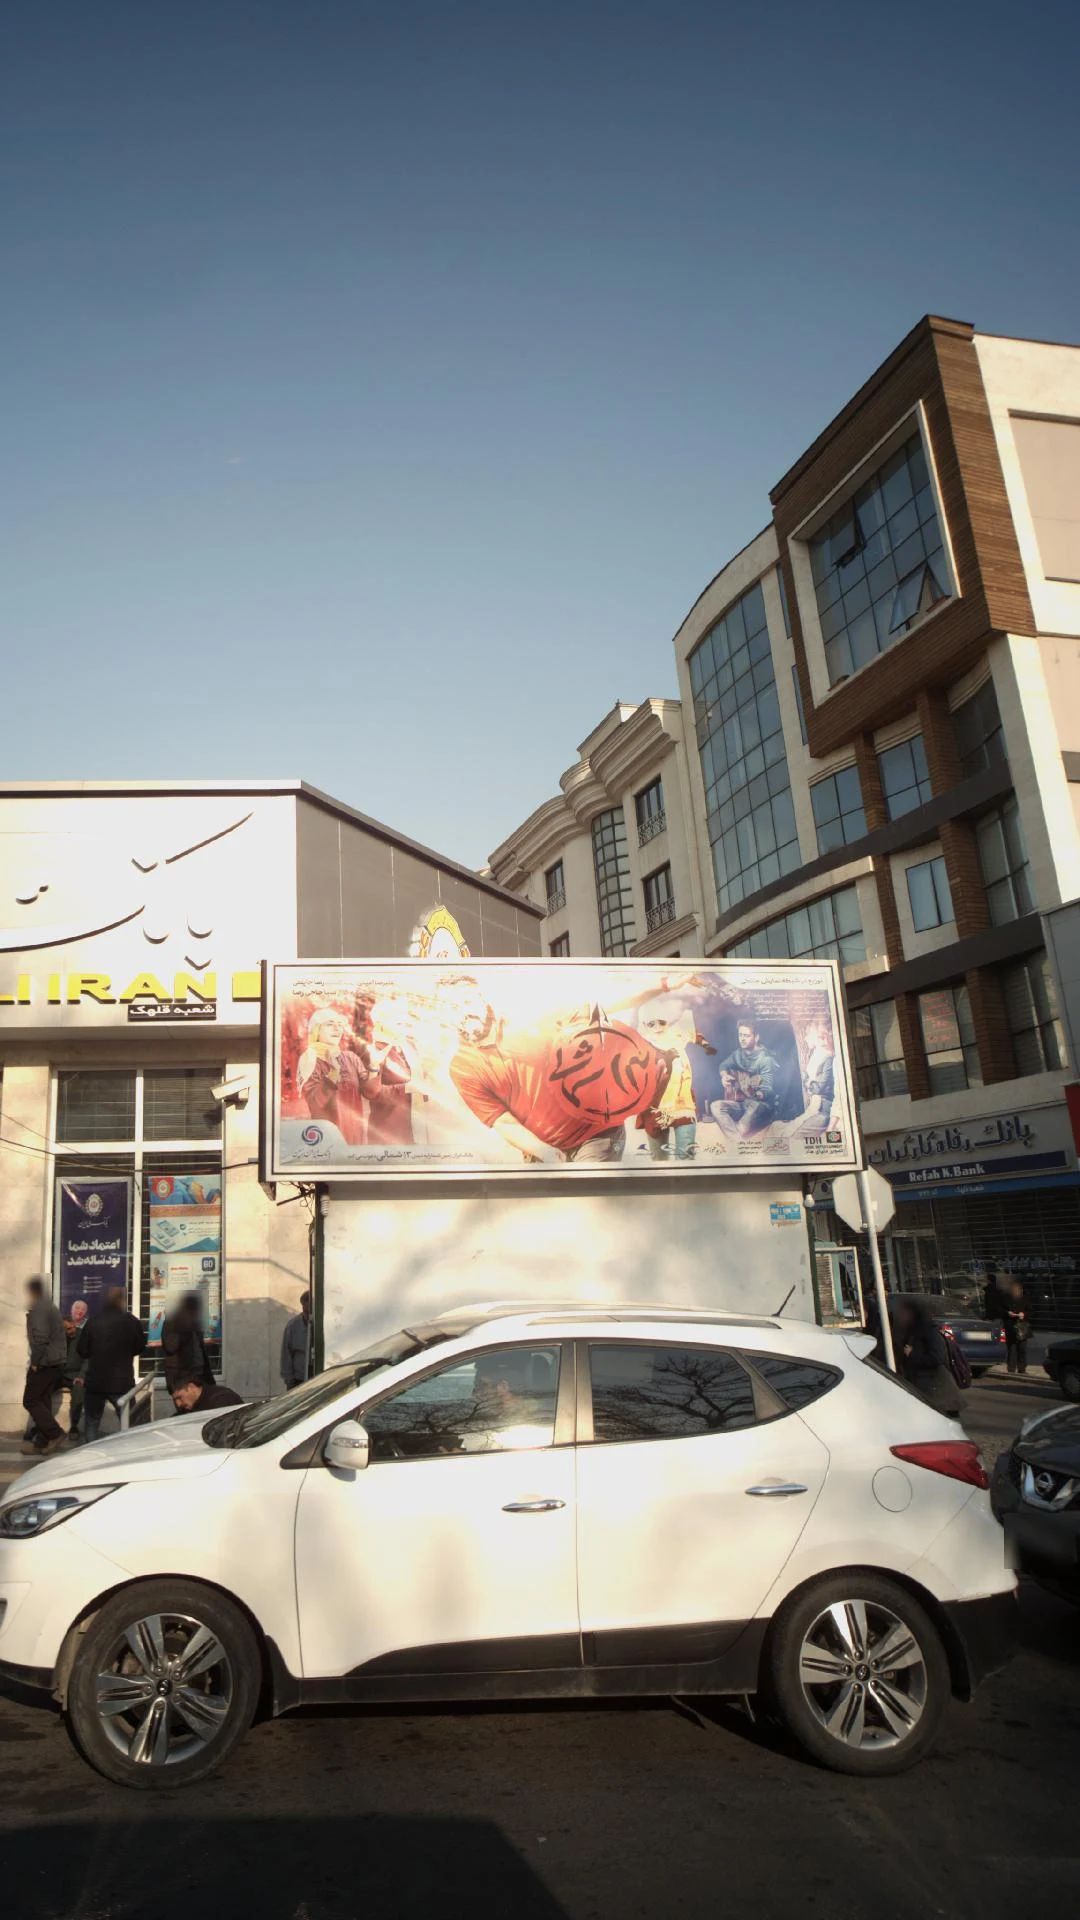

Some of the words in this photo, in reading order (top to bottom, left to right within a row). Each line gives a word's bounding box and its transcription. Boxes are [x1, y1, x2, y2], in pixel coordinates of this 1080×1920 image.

[48, 972, 217, 1004] IRAN
[129, 1005, 171, 1017] قلهک
[173, 1004, 215, 1016] شعبه
[936, 1127, 975, 1153] رفاه
[909, 1169, 941, 1183] Refah
[953, 1163, 985, 1177] Bank
[68, 1239, 89, 1252] شما
[89, 1238, 121, 1251] اعتماد
